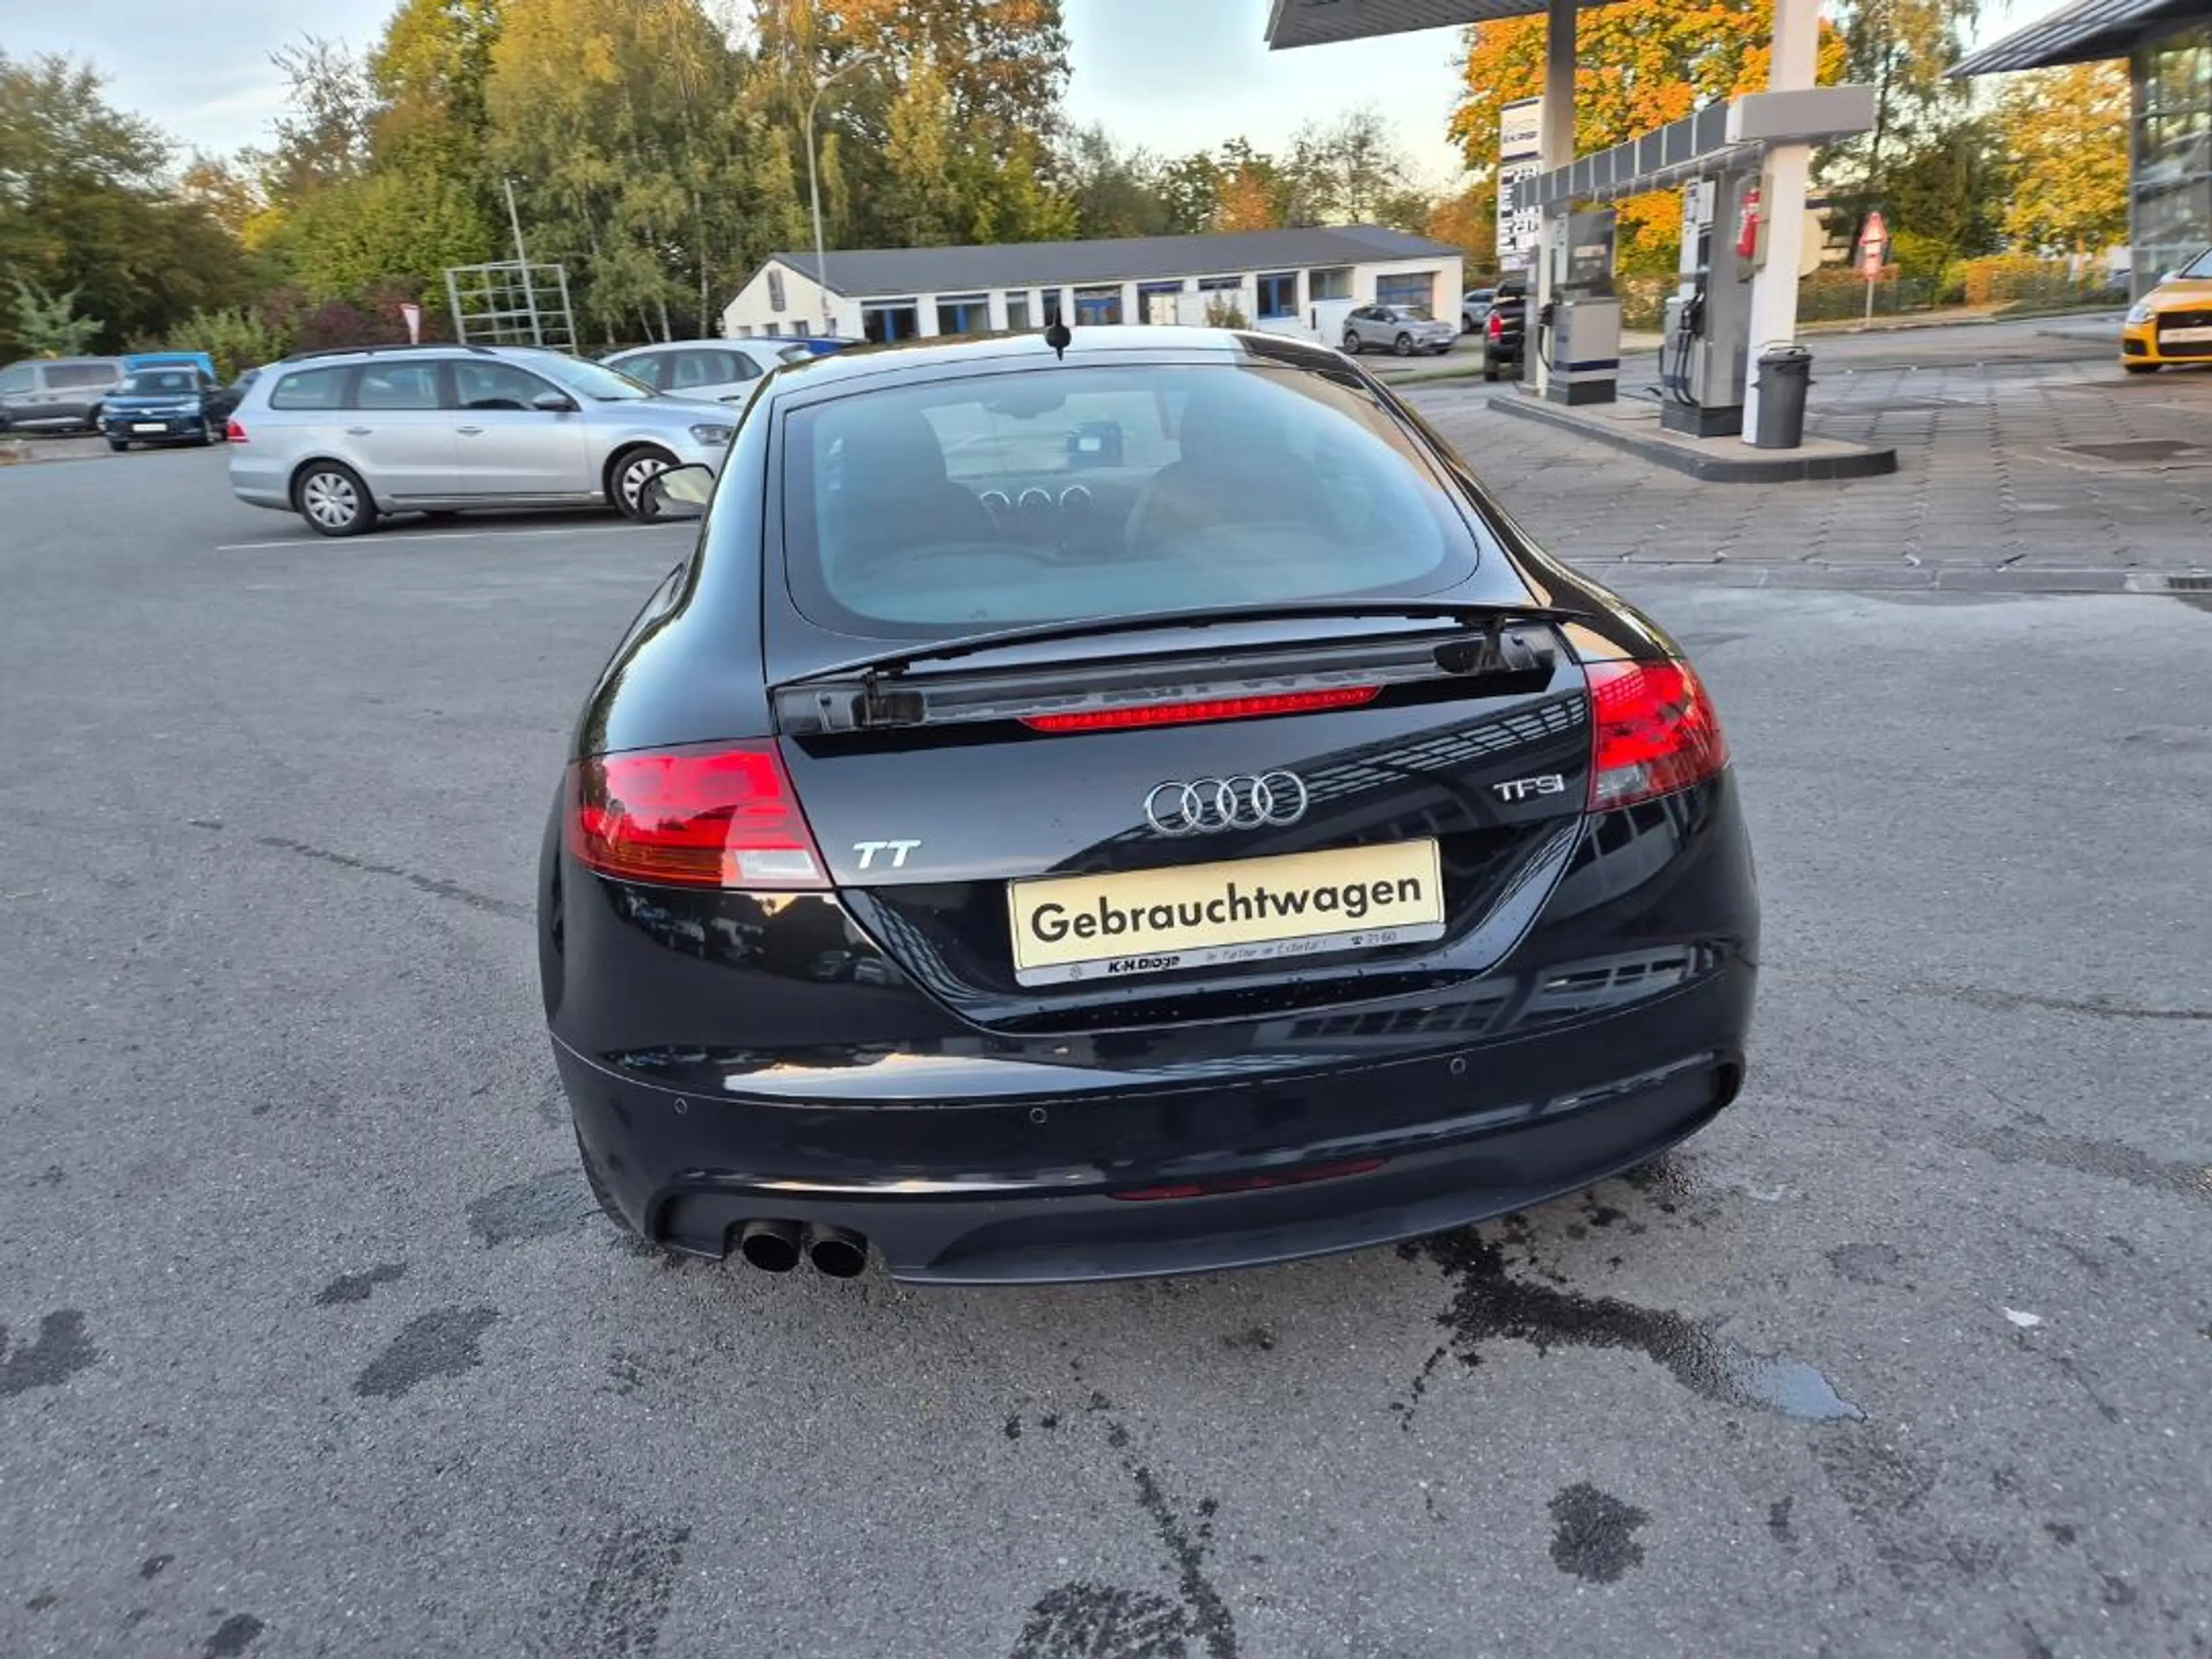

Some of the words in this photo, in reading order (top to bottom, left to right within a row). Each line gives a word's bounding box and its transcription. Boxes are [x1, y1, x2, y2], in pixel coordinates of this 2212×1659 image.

[1493, 774, 1565, 801] TFSI
[853, 839, 921, 869] TT
[1032, 878, 1421, 942] Gebrauchtwagen
